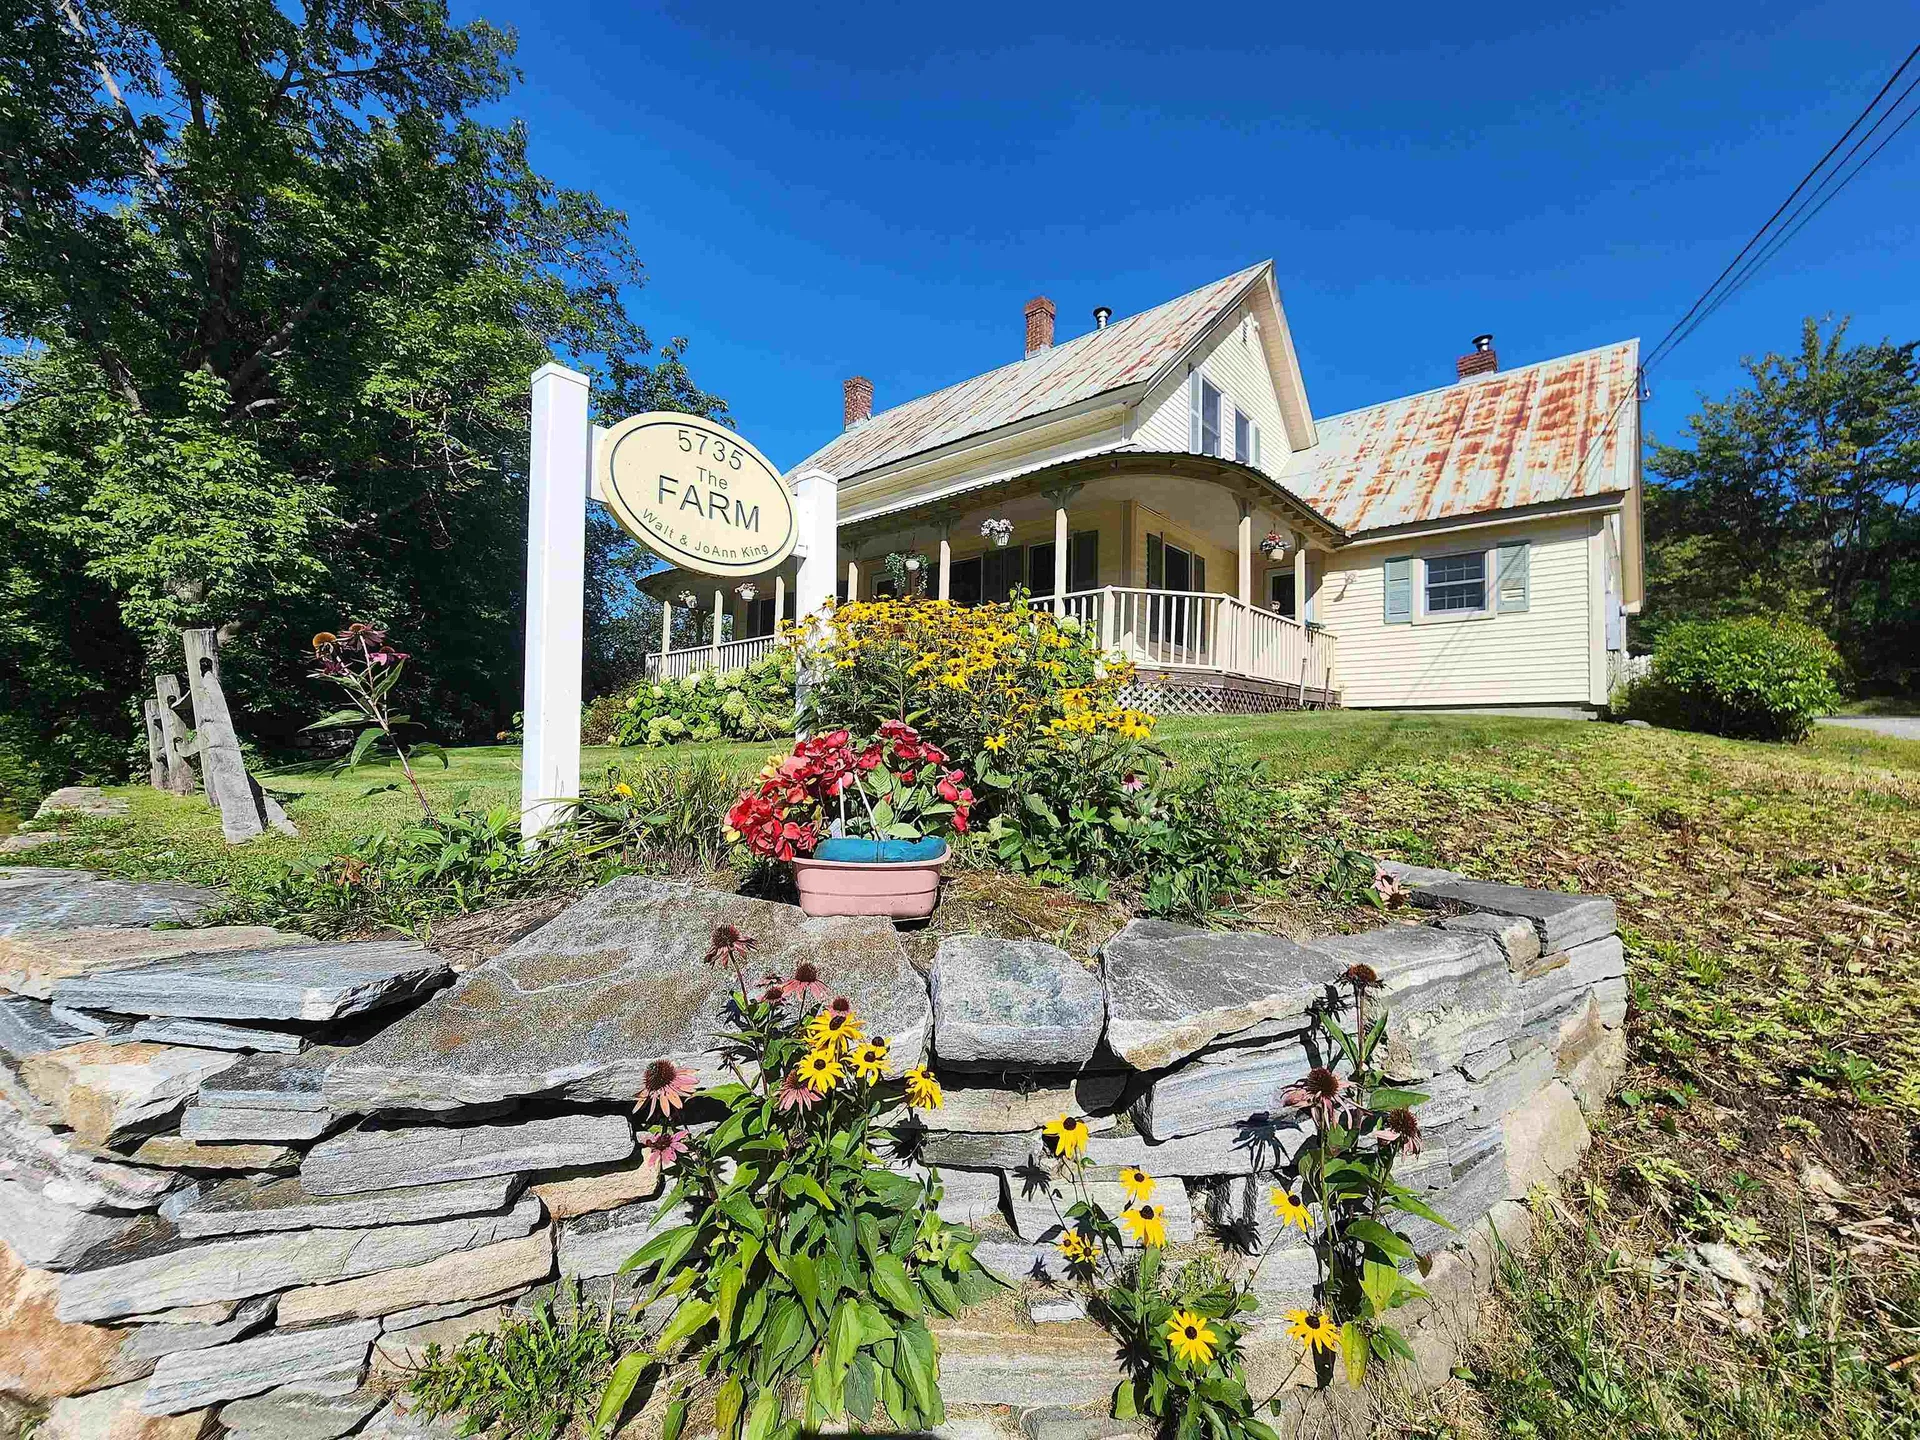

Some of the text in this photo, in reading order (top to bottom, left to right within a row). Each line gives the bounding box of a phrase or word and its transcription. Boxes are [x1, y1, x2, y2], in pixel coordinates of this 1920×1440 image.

[678, 429, 744, 471] 5735
[696, 466, 728, 490] The
[658, 474, 759, 533] FARM
[643, 508, 769, 559] Walt & JoAnn King
